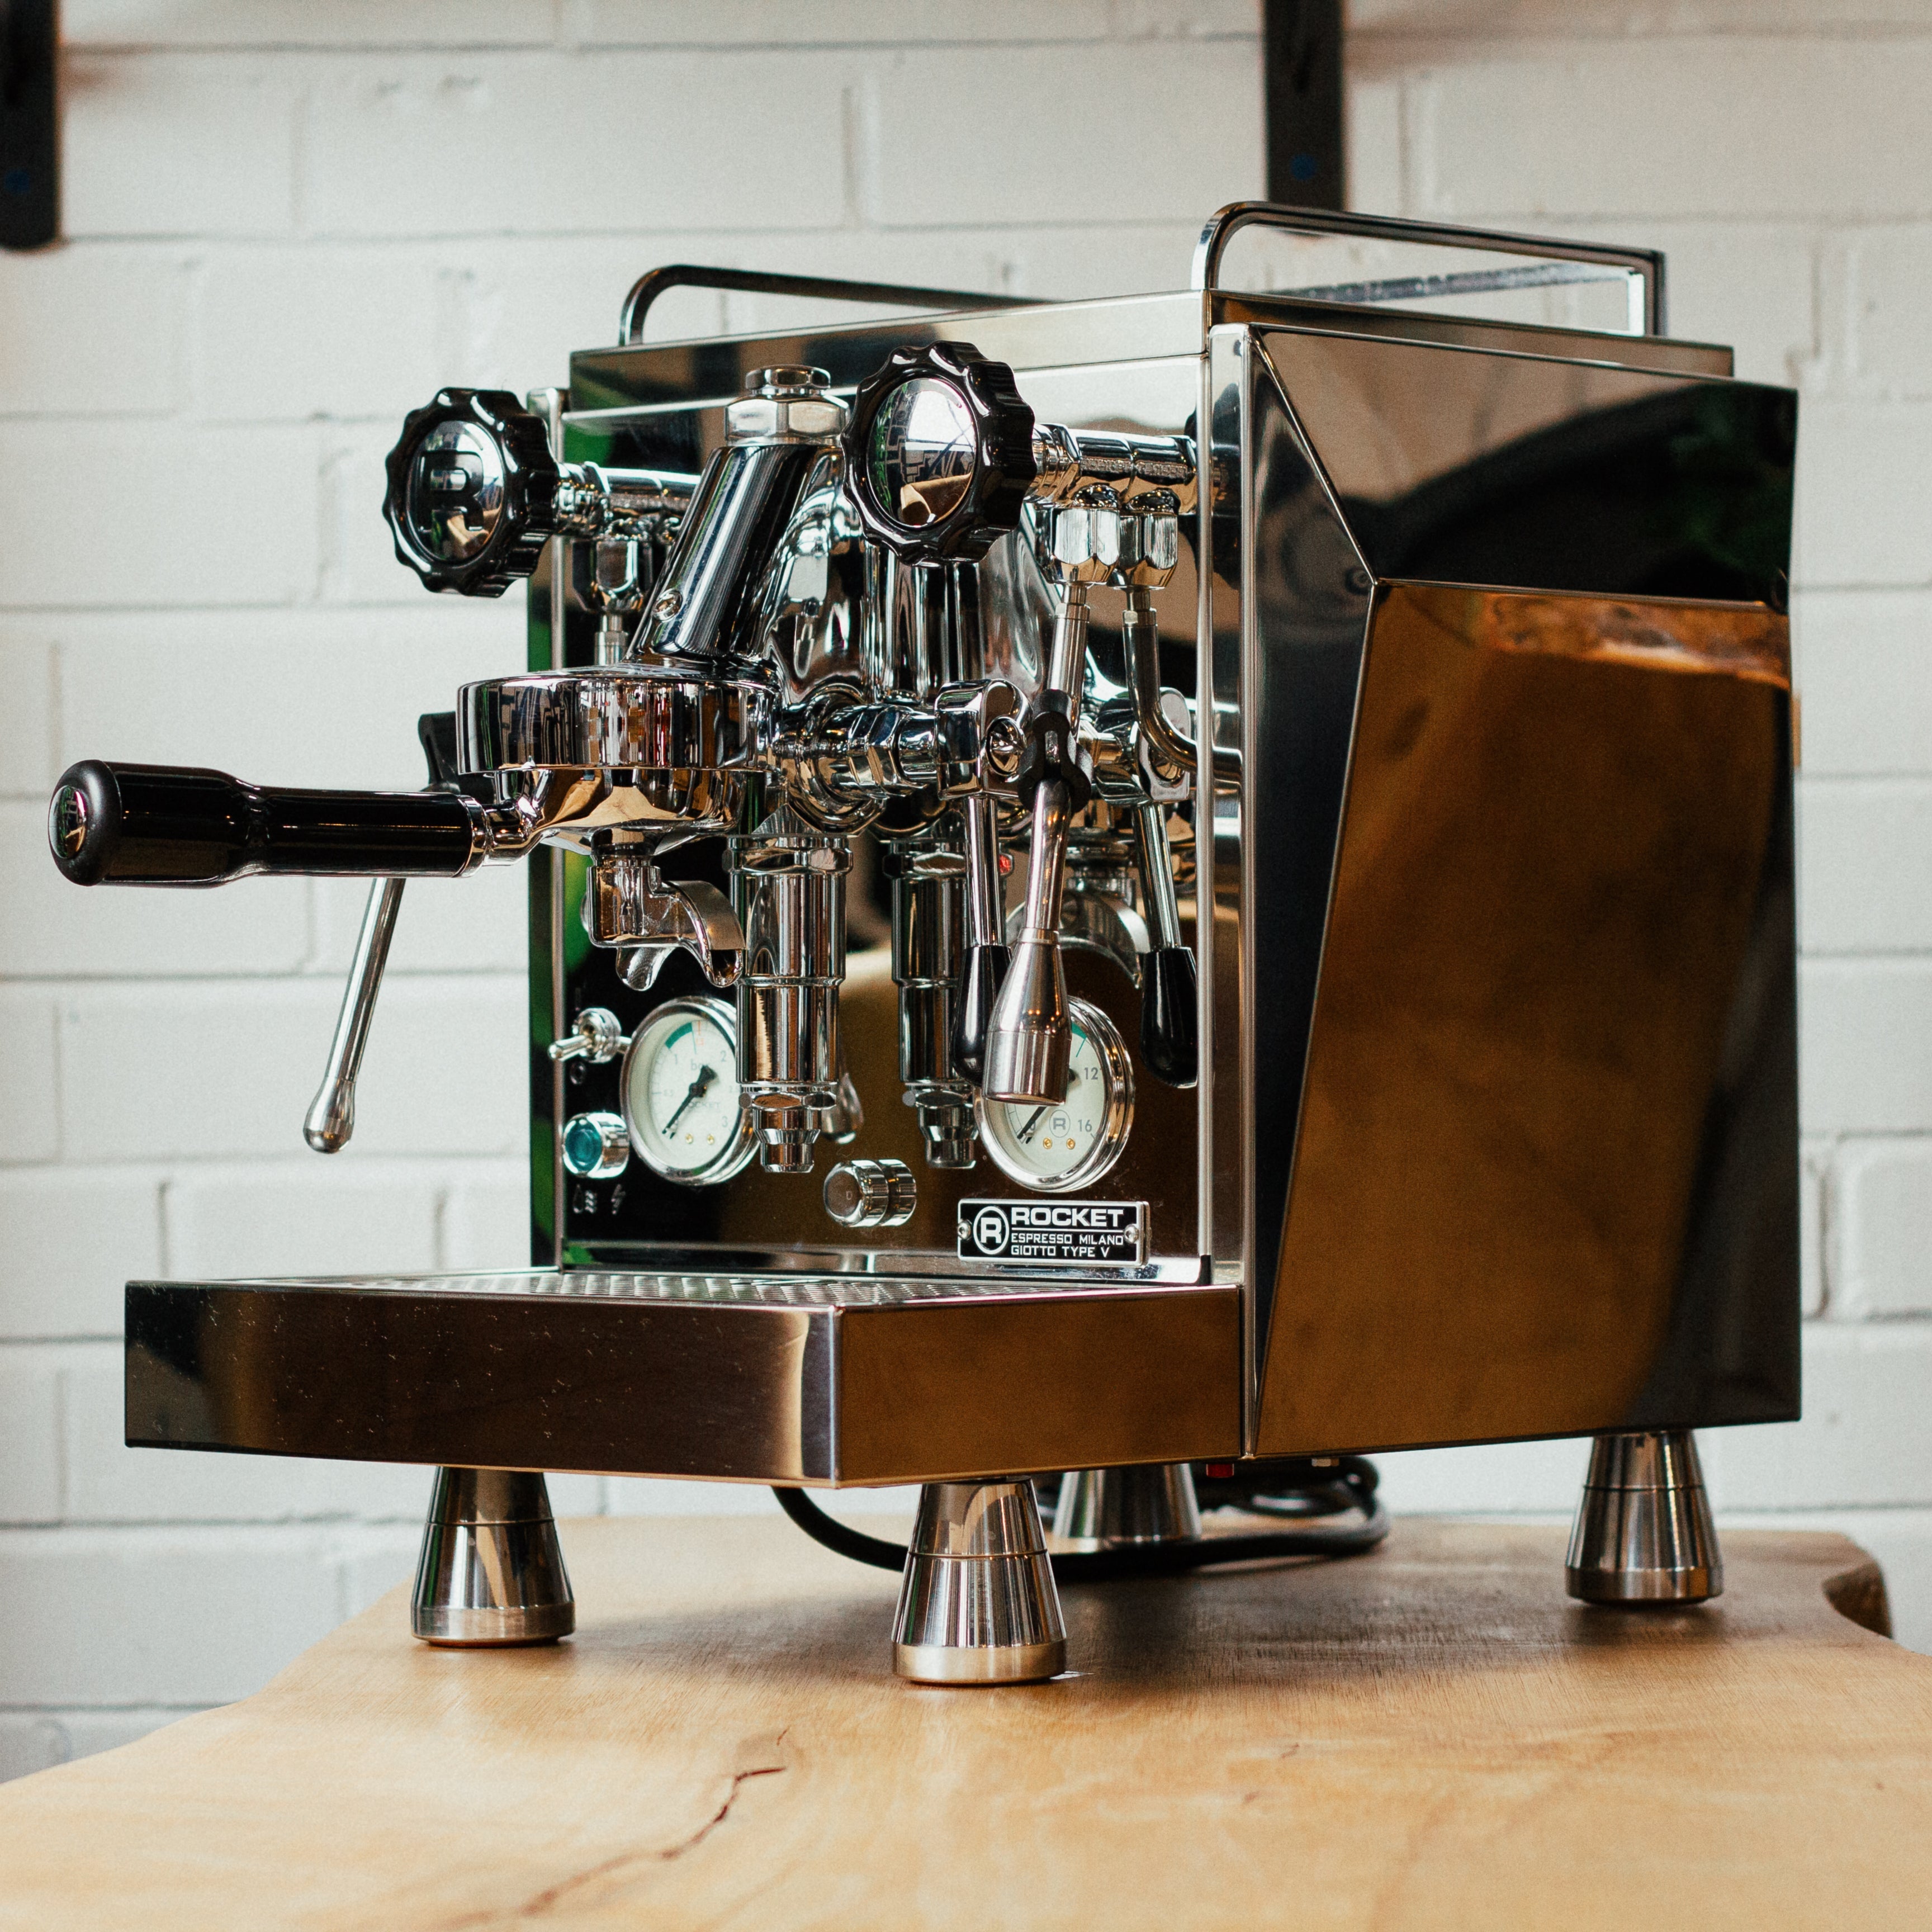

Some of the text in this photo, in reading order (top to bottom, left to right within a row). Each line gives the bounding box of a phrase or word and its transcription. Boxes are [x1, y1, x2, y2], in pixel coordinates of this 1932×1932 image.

[418, 451, 484, 532] R
[674, 1054, 678, 1065] 1
[720, 1050, 727, 1062] 2
[1084, 1067, 1098, 1080] 12
[721, 1116, 728, 1128] 3
[1053, 1117, 1066, 1130] R
[1078, 1119, 1092, 1132] 16
[1011, 1207, 1124, 1227] ROCKET
[981, 1217, 1002, 1244] R
[1011, 1233, 1124, 1246] ESPRESSO MILANO
[1011, 1245, 1110, 1258] GIOTTO TYPE V
